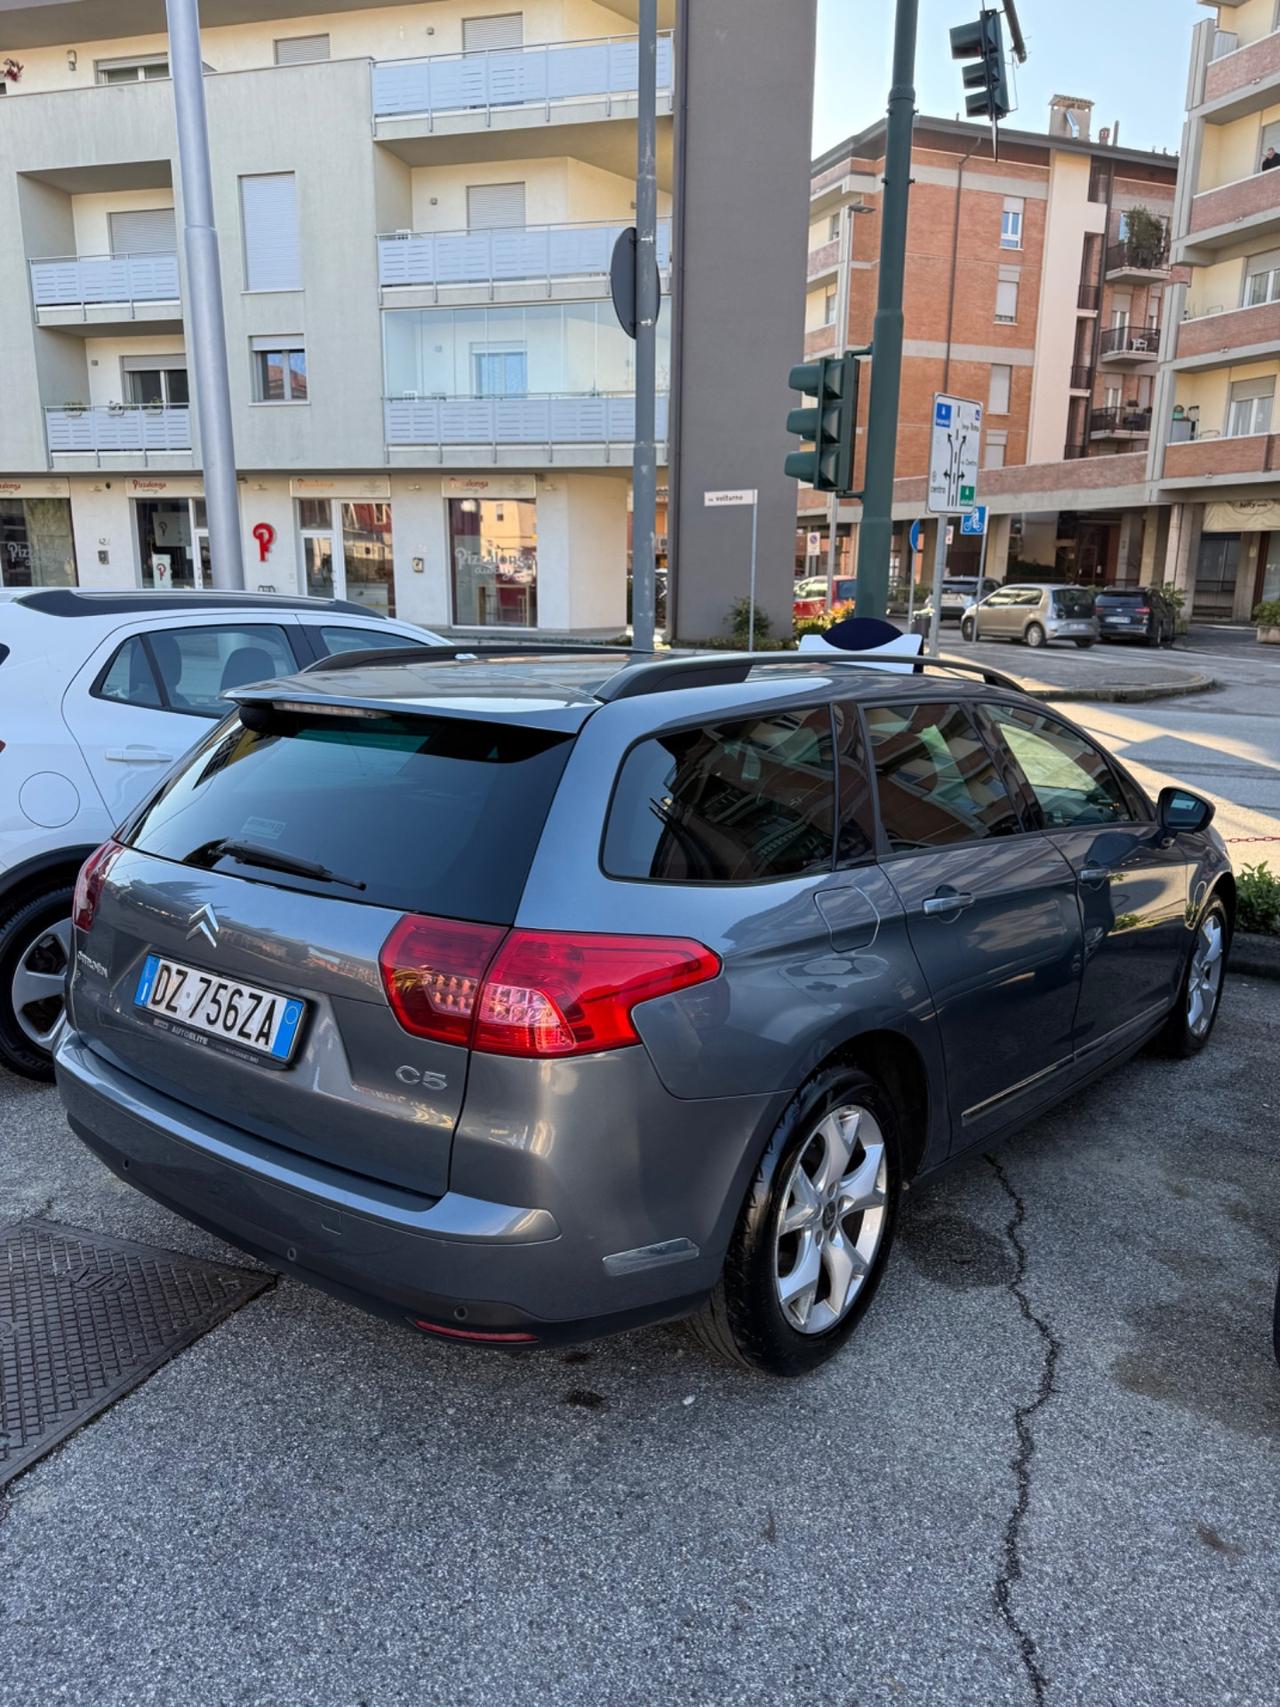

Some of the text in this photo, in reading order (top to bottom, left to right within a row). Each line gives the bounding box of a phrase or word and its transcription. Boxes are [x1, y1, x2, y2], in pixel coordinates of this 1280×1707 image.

[151, 964, 188, 1013] DZ
[189, 977, 277, 1046] 756ZA
[395, 1065, 448, 1090] C5
